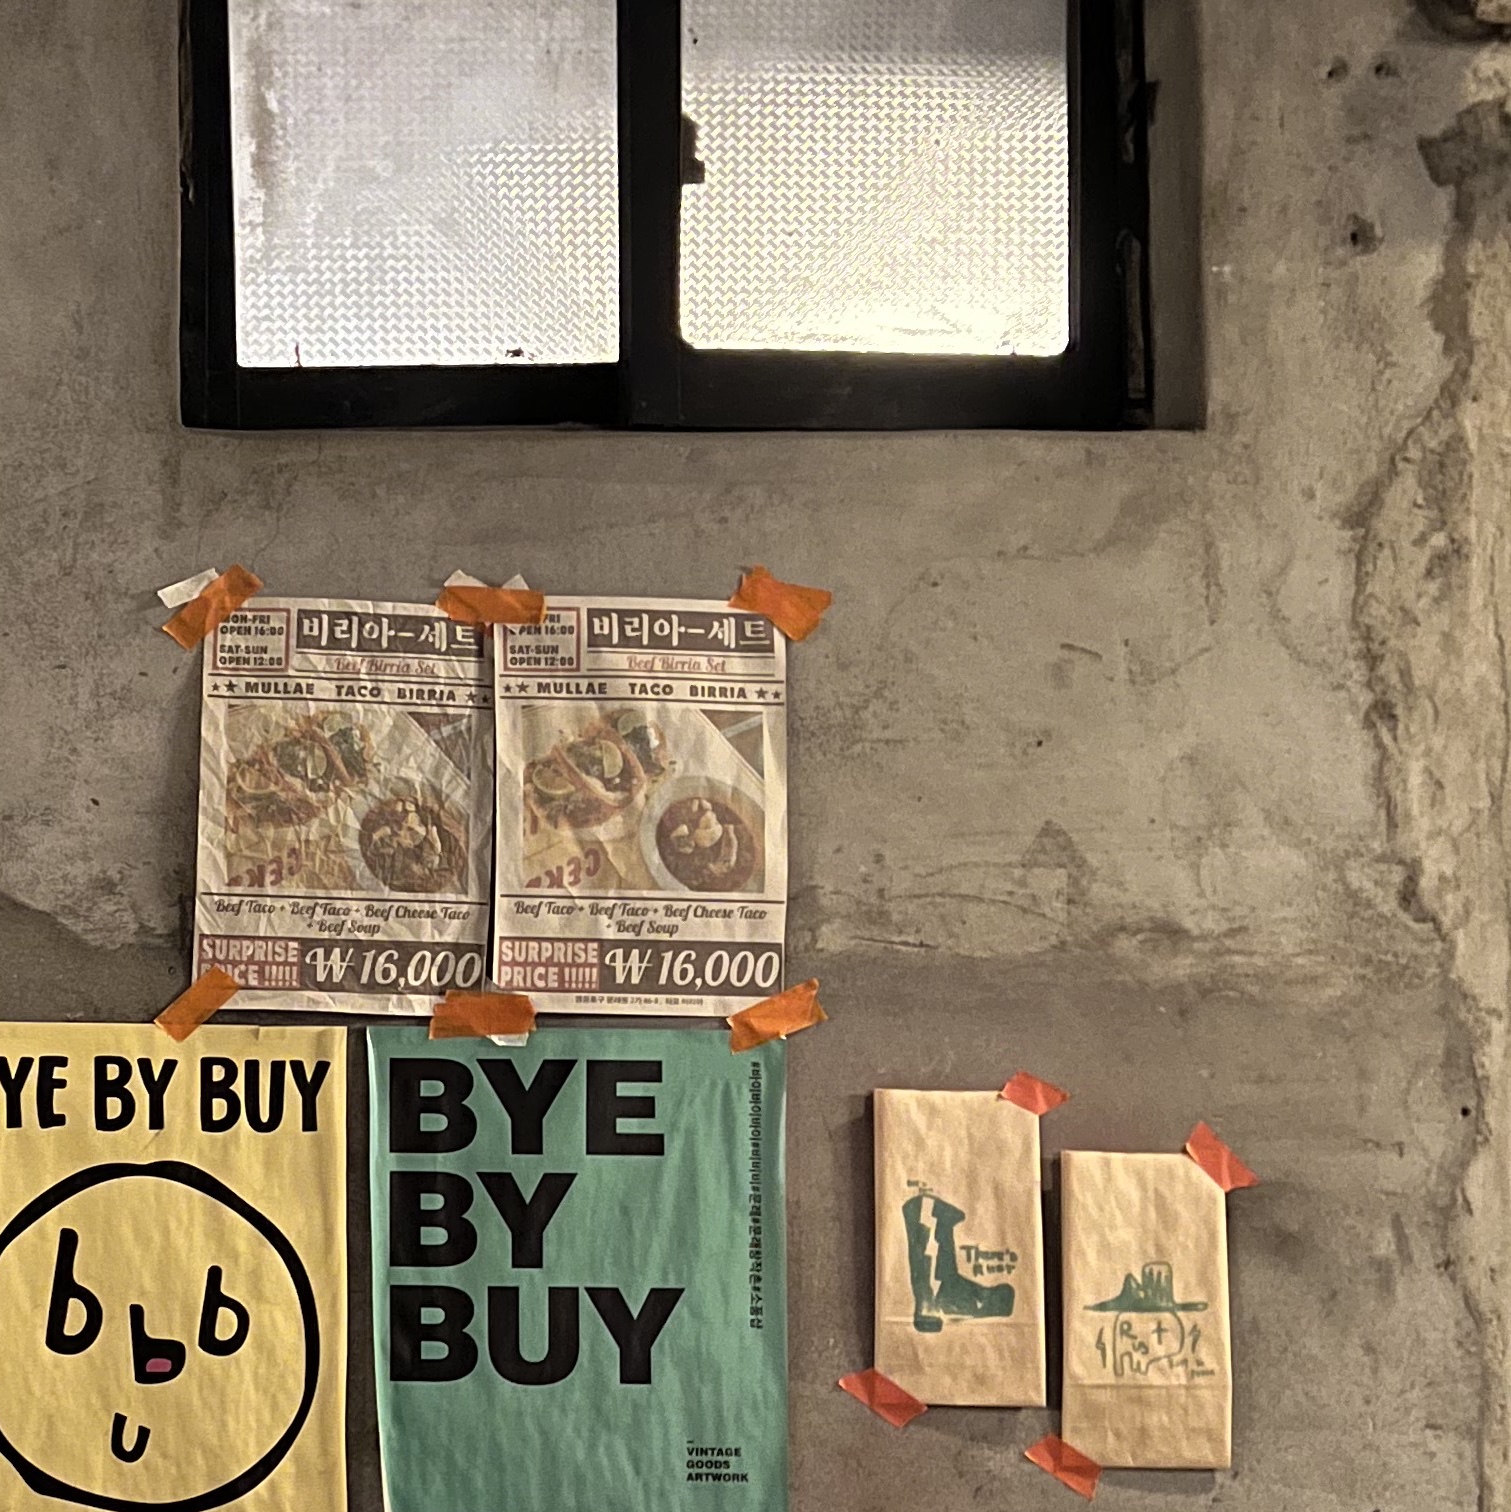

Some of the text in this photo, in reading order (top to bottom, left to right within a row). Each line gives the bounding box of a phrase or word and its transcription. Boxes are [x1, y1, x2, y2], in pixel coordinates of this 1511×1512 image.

[220, 625, 284, 636] OPEN 16:00
[302, 613, 479, 652] 비리아-세트
[544, 625, 575, 635] 16:00
[592, 612, 771, 649] 비리아-세트
[219, 656, 283, 666] OPEN 12:00
[367, 659, 410, 674] Birria
[414, 660, 437, 675] Set
[509, 656, 575, 666] OPEN 12:00
[626, 656, 727, 673] Beef Birria Set
[244, 681, 456, 702] MULLAE TACO BIRRIA
[537, 681, 748, 699] MULLAE TACO BIRRIA
[215, 899, 245, 916] Beef
[246, 900, 276, 914] Taco
[287, 900, 320, 917] Beef
[320, 902, 351, 916] Taco
[364, 904, 394, 921] Beef
[395, 905, 438, 920] Cheese
[440, 907, 470, 921] Taco
[514, 900, 545, 917] Beef
[545, 901, 575, 915] Taco
[587, 901, 618, 918] Beef
[618, 902, 649, 917] Taco
[662, 903, 693, 921] Beef
[693, 905, 734, 920] Cheese
[737, 907, 768, 920] Taco
[318, 920, 348, 937] Beef
[348, 920, 381, 936] Soup
[615, 920, 646, 937] Beef
[646, 920, 679, 937] Soup
[201, 938, 300, 962] SURPRISE
[500, 941, 599, 964] SURPRISE
[200, 963, 259, 987] PICE
[360, 949, 482, 991] 16,000
[500, 966, 559, 989] PRICE
[658, 949, 780, 991] 16,000
[94, 1055, 179, 1132] BY
[200, 1056, 331, 1133] BUY
[389, 1057, 666, 1156] BYE
[389, 1171, 578, 1269] BY
[389, 1286, 685, 1385] BUY
[687, 1447, 742, 1457] VINTAGE
[686, 1459, 731, 1469] GOODS
[686, 1472, 749, 1482] ARTWORK
